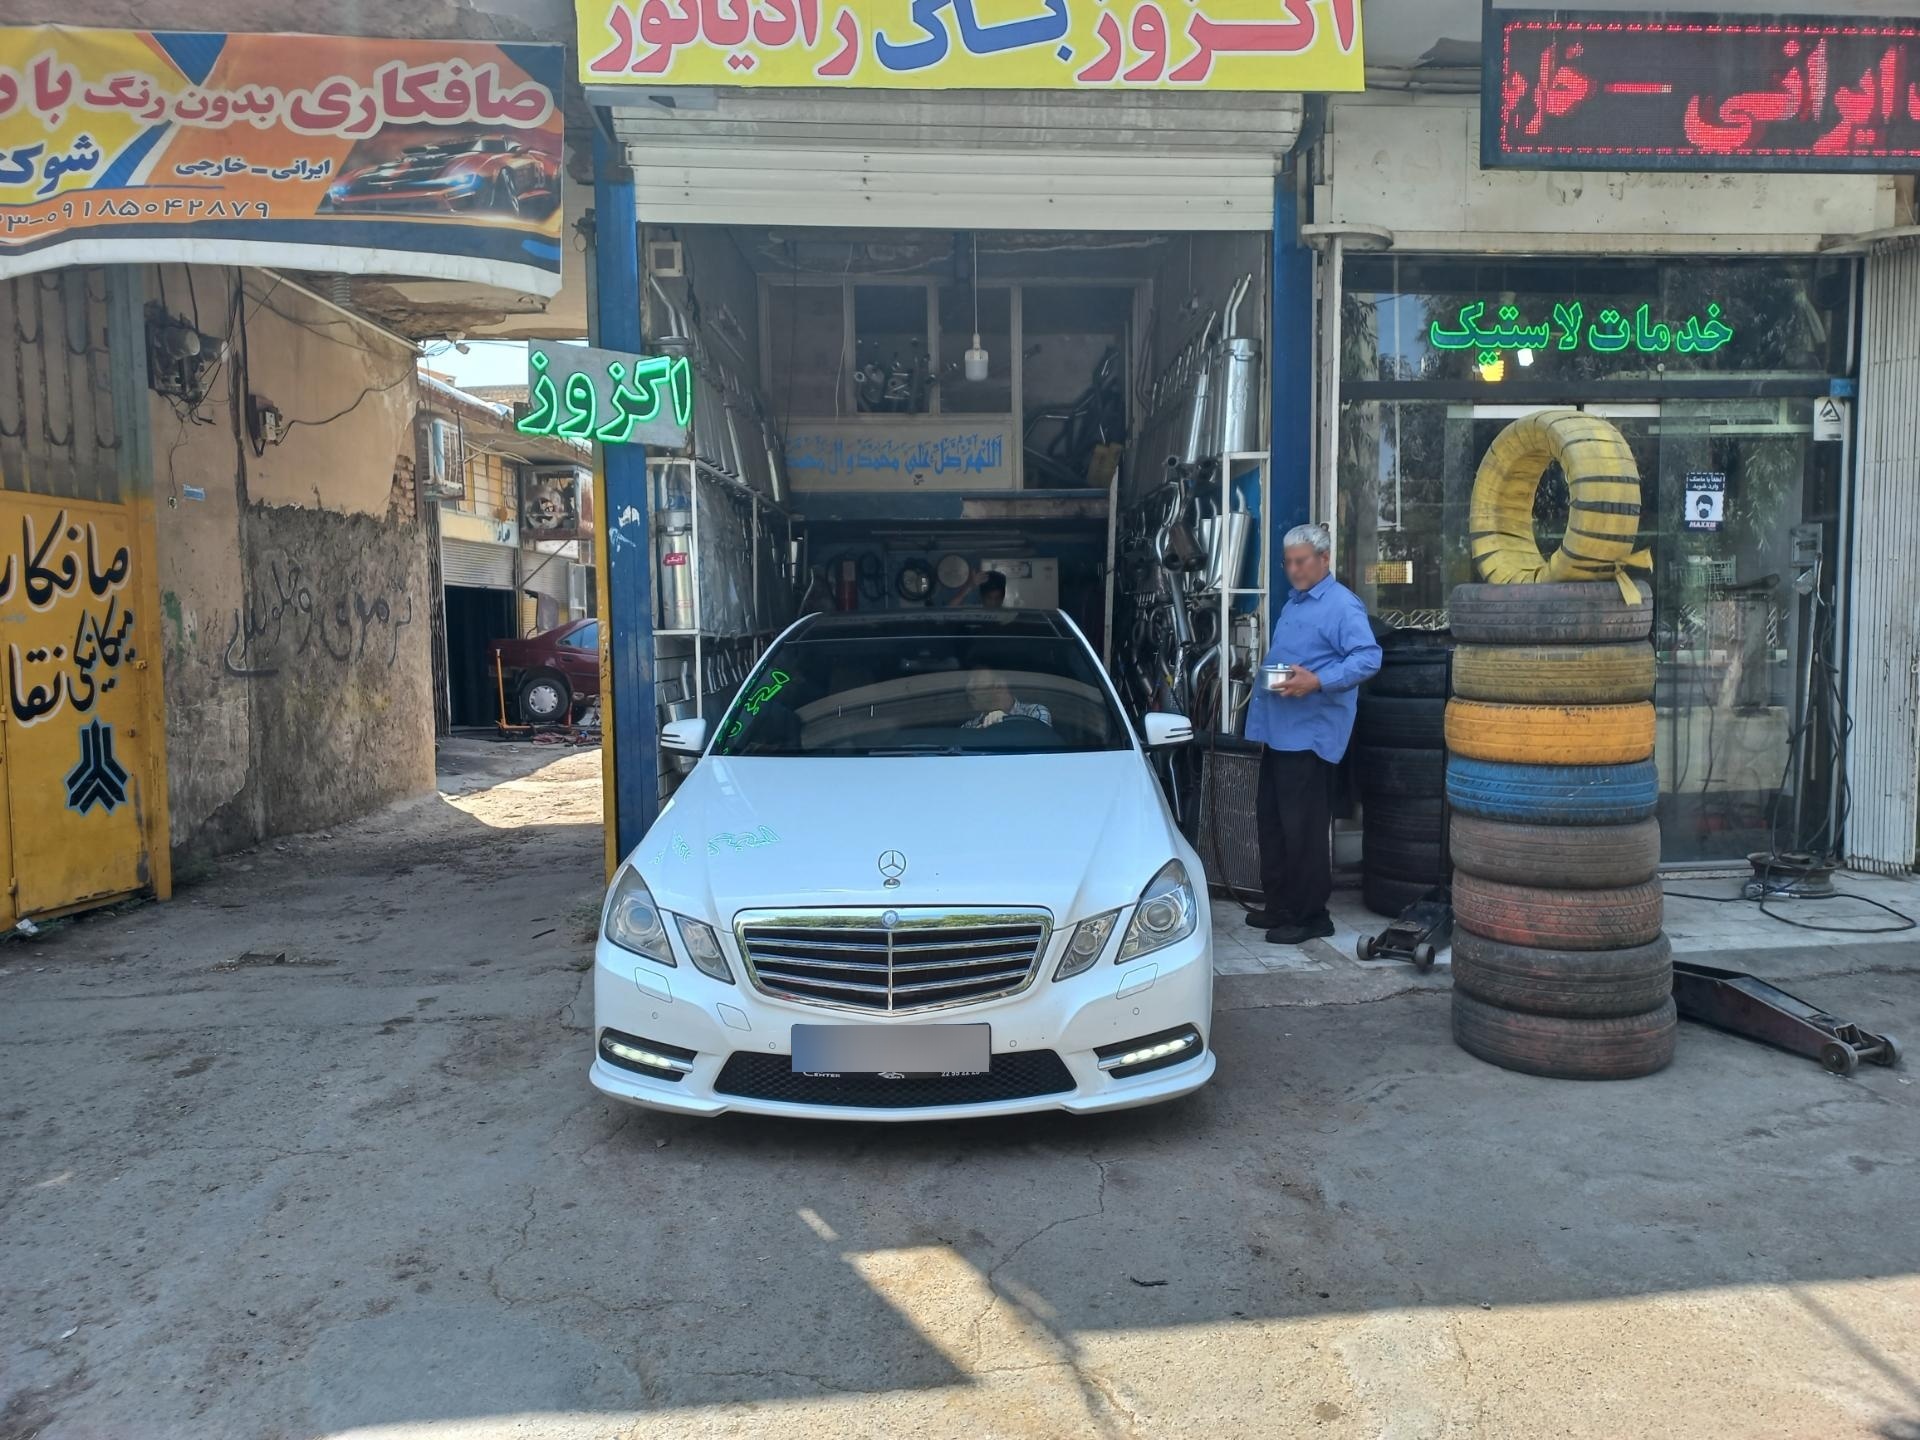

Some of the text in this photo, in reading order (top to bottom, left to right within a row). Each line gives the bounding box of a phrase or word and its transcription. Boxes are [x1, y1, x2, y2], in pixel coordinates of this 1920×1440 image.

[33, 56, 73, 125] با
[83, 76, 166, 119] رنگ
[174, 90, 275, 122] بدون
[288, 64, 548, 134] صافکاری
[1684, 38, 1897, 154] ایرانی
[0, 134, 100, 196] شوک
[1430, 301, 1734, 366] خدمات لاستیک
[516, 350, 692, 443] اگزوز
